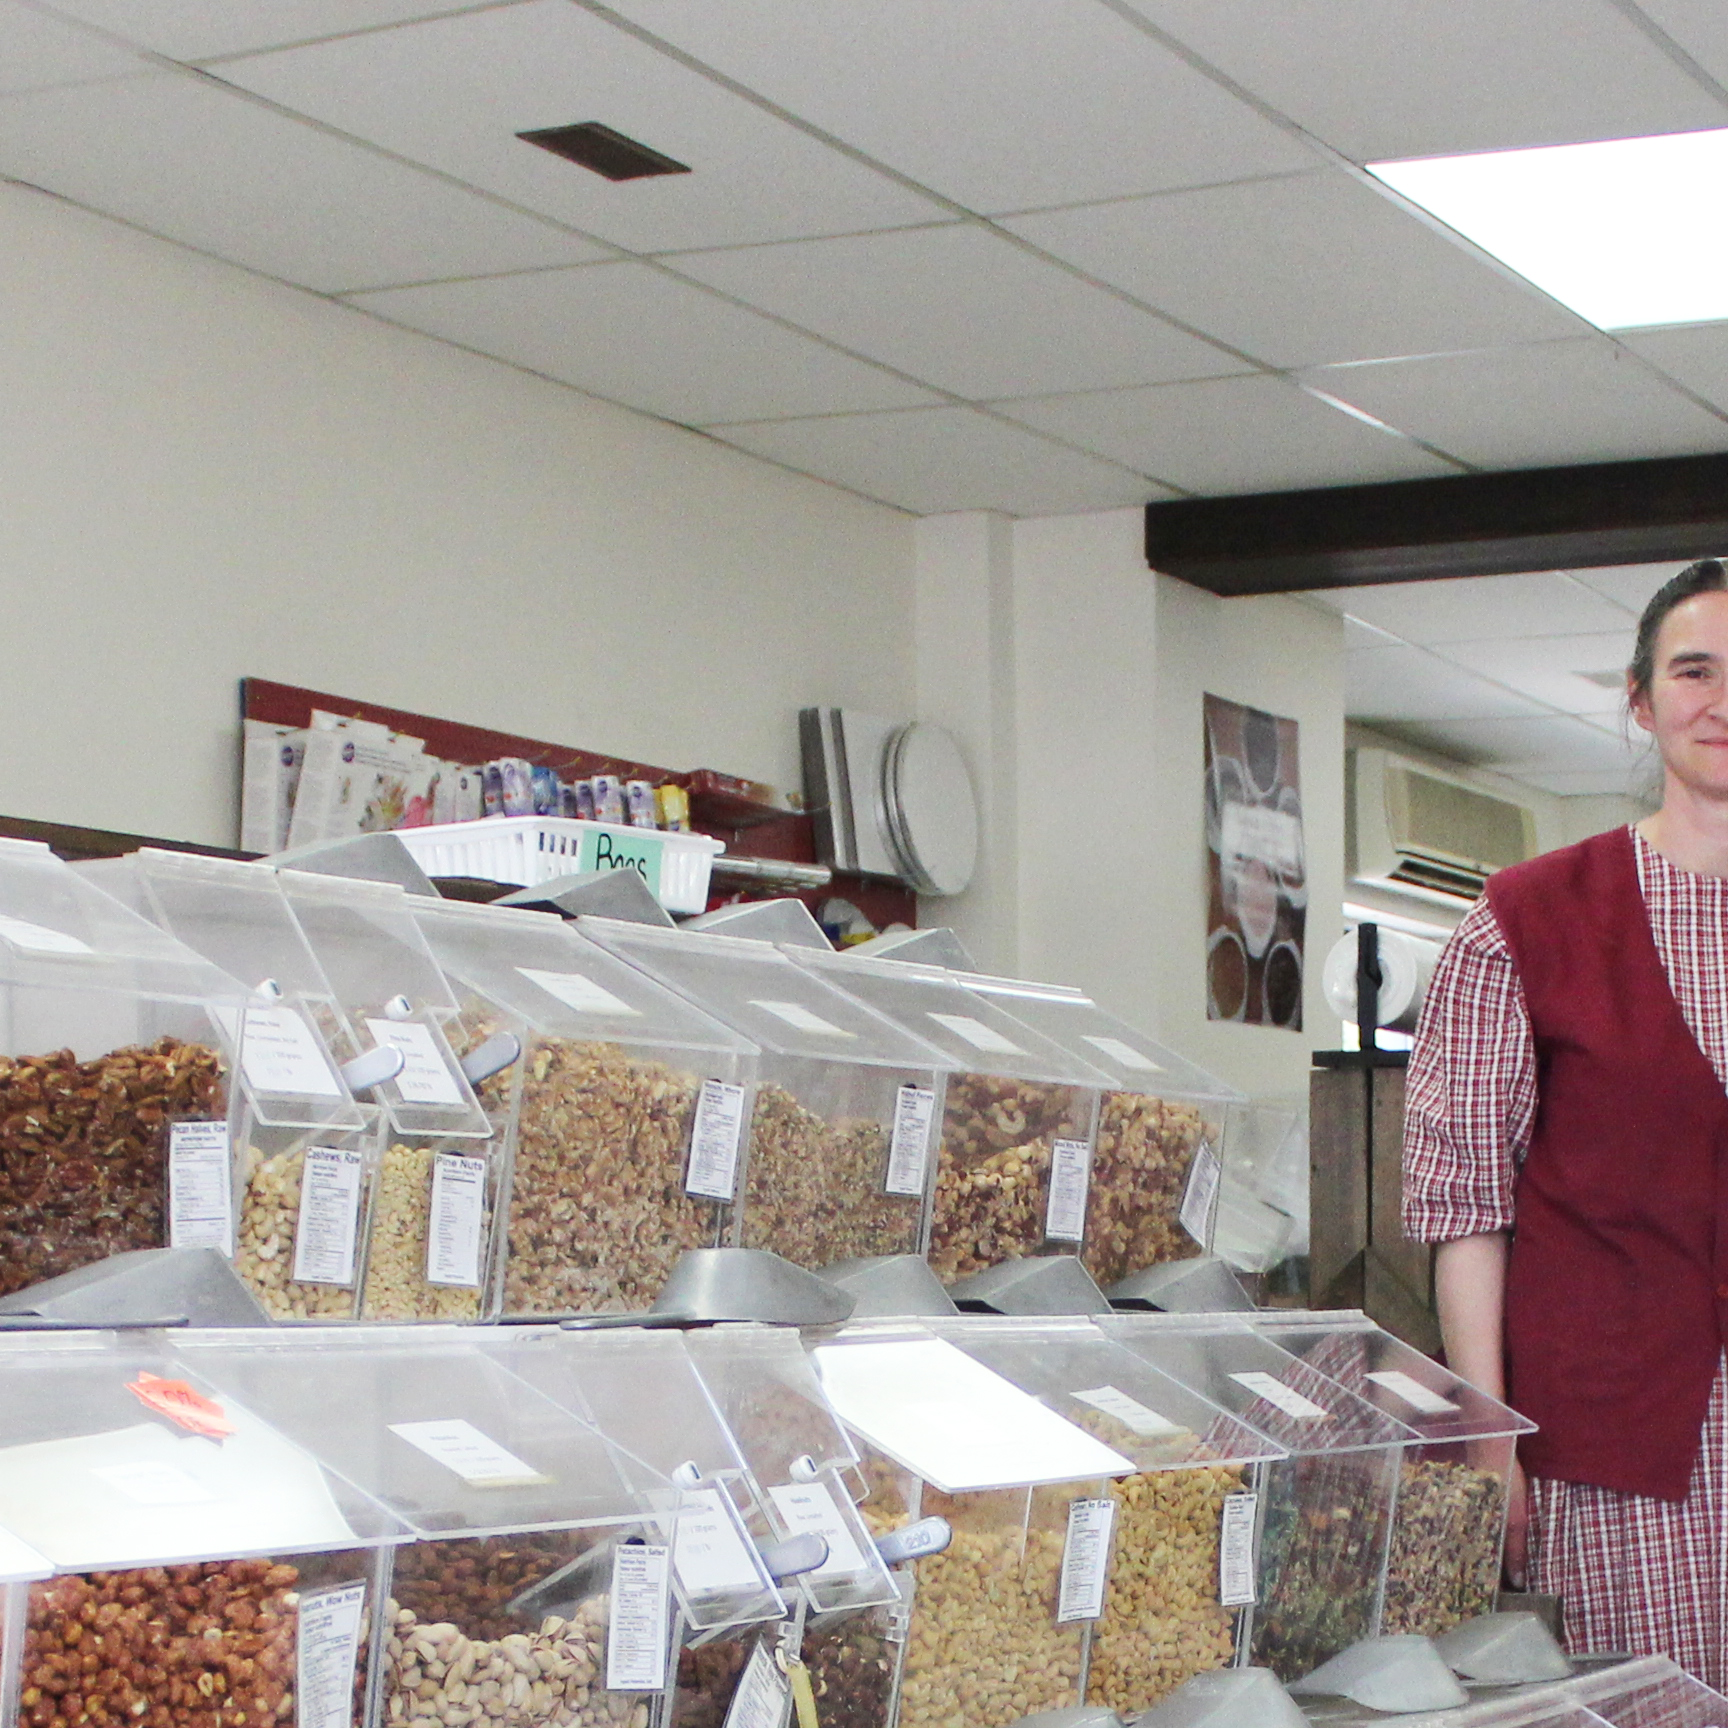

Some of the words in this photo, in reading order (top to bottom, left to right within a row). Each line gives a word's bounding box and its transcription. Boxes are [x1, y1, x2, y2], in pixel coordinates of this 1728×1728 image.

[344, 1152, 360, 1164] Raw
[436, 1155, 457, 1167] Pine
[460, 1159, 483, 1171] Nuts
